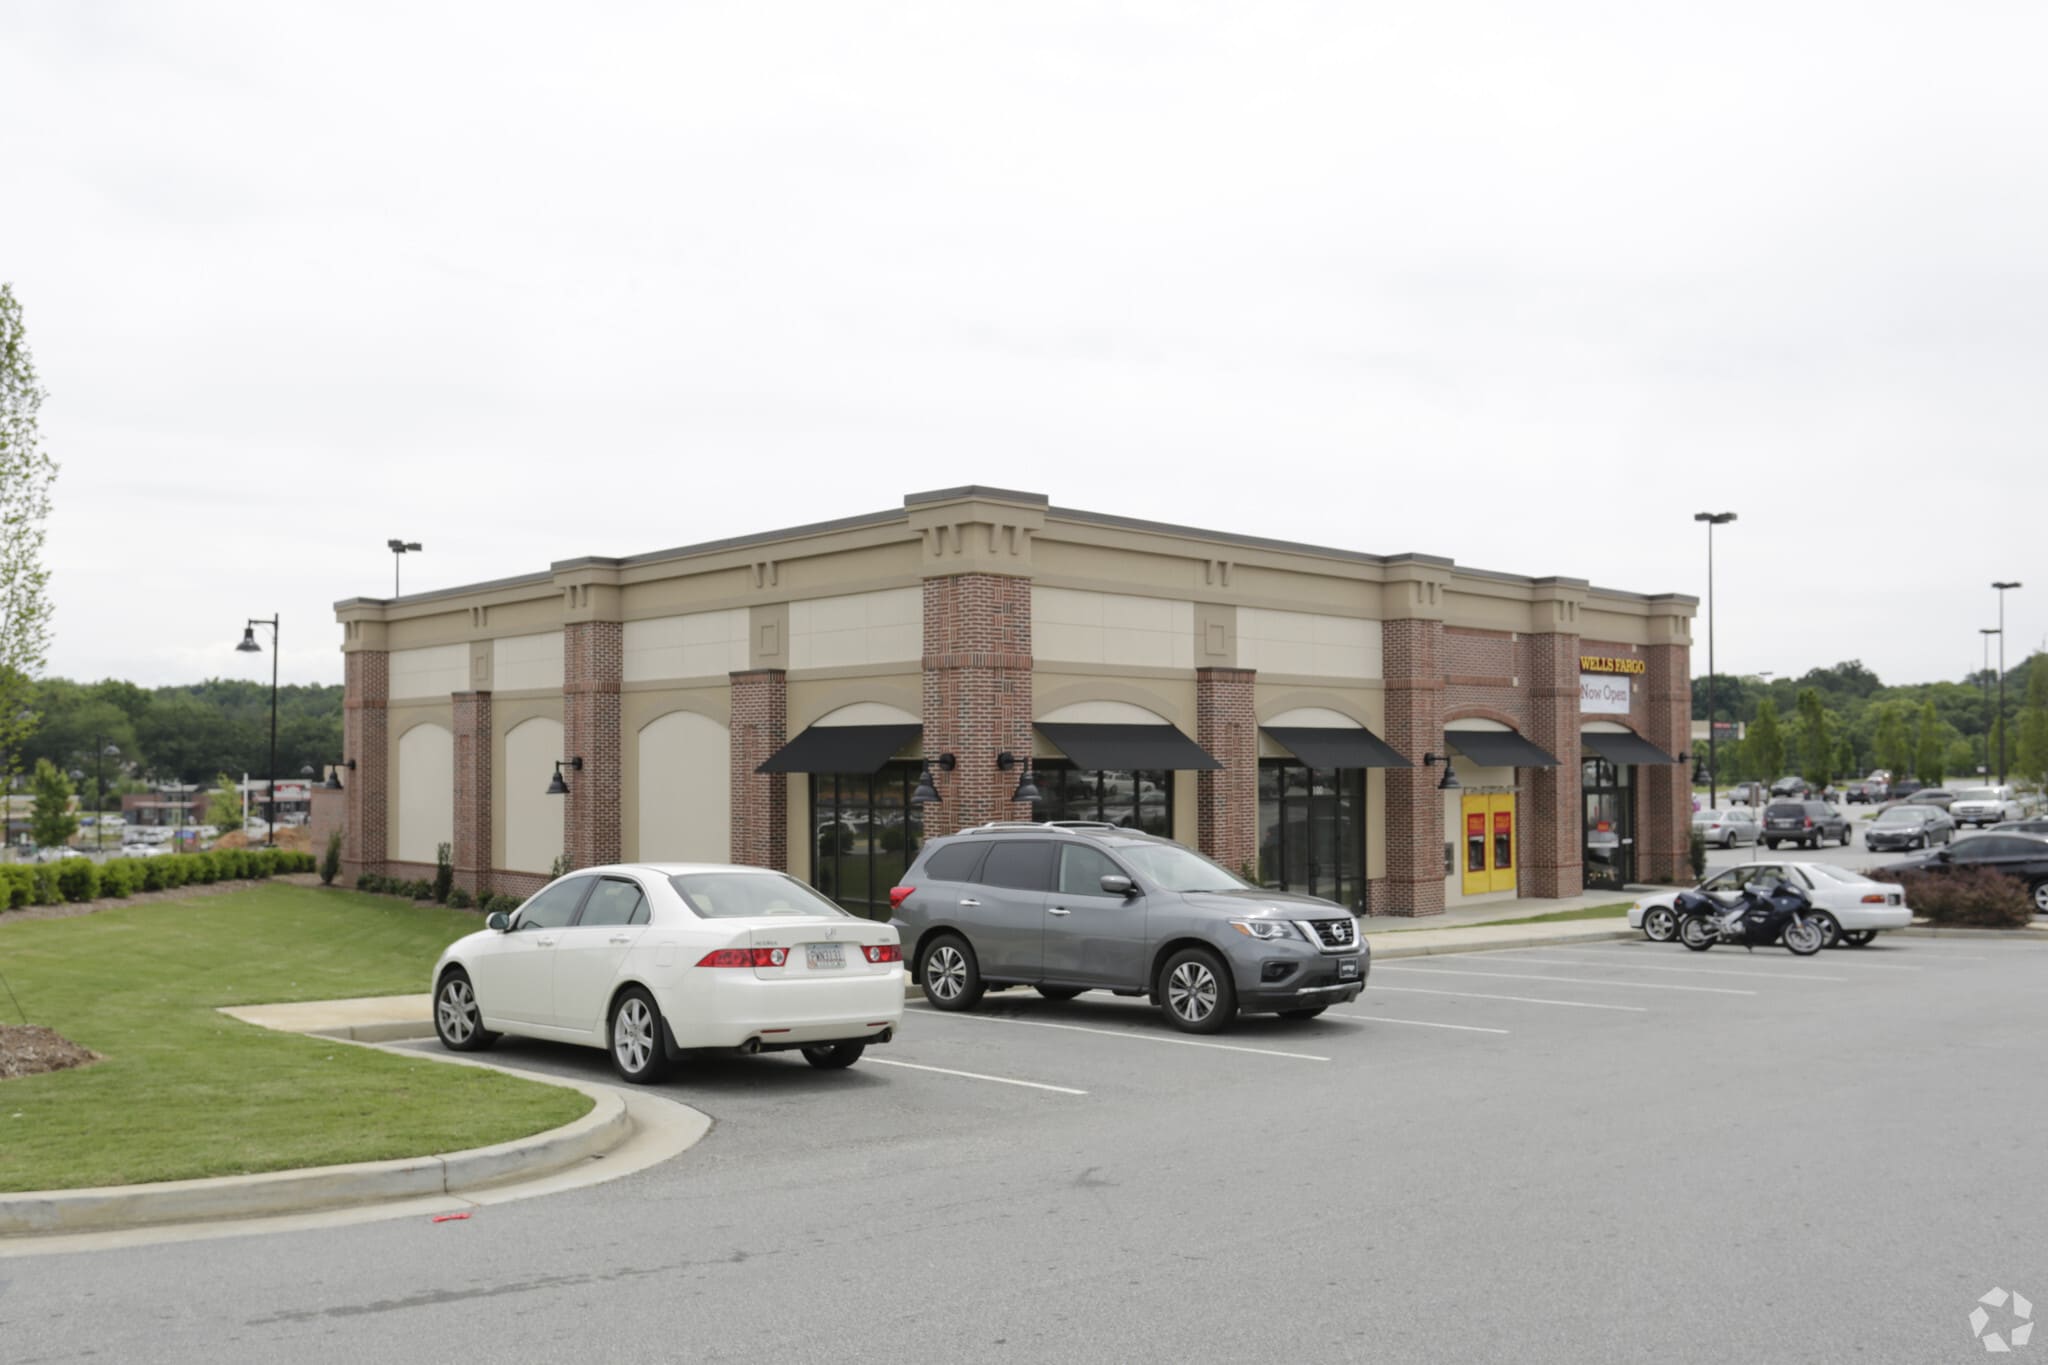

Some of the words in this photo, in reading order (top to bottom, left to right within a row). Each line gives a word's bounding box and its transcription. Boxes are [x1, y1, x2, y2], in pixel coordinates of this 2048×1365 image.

[1580, 656, 1614, 672] WELLS
[1615, 658, 1646, 674] FARGO
[1581, 684, 1602, 700] Now
[1603, 685, 1627, 704] Open
